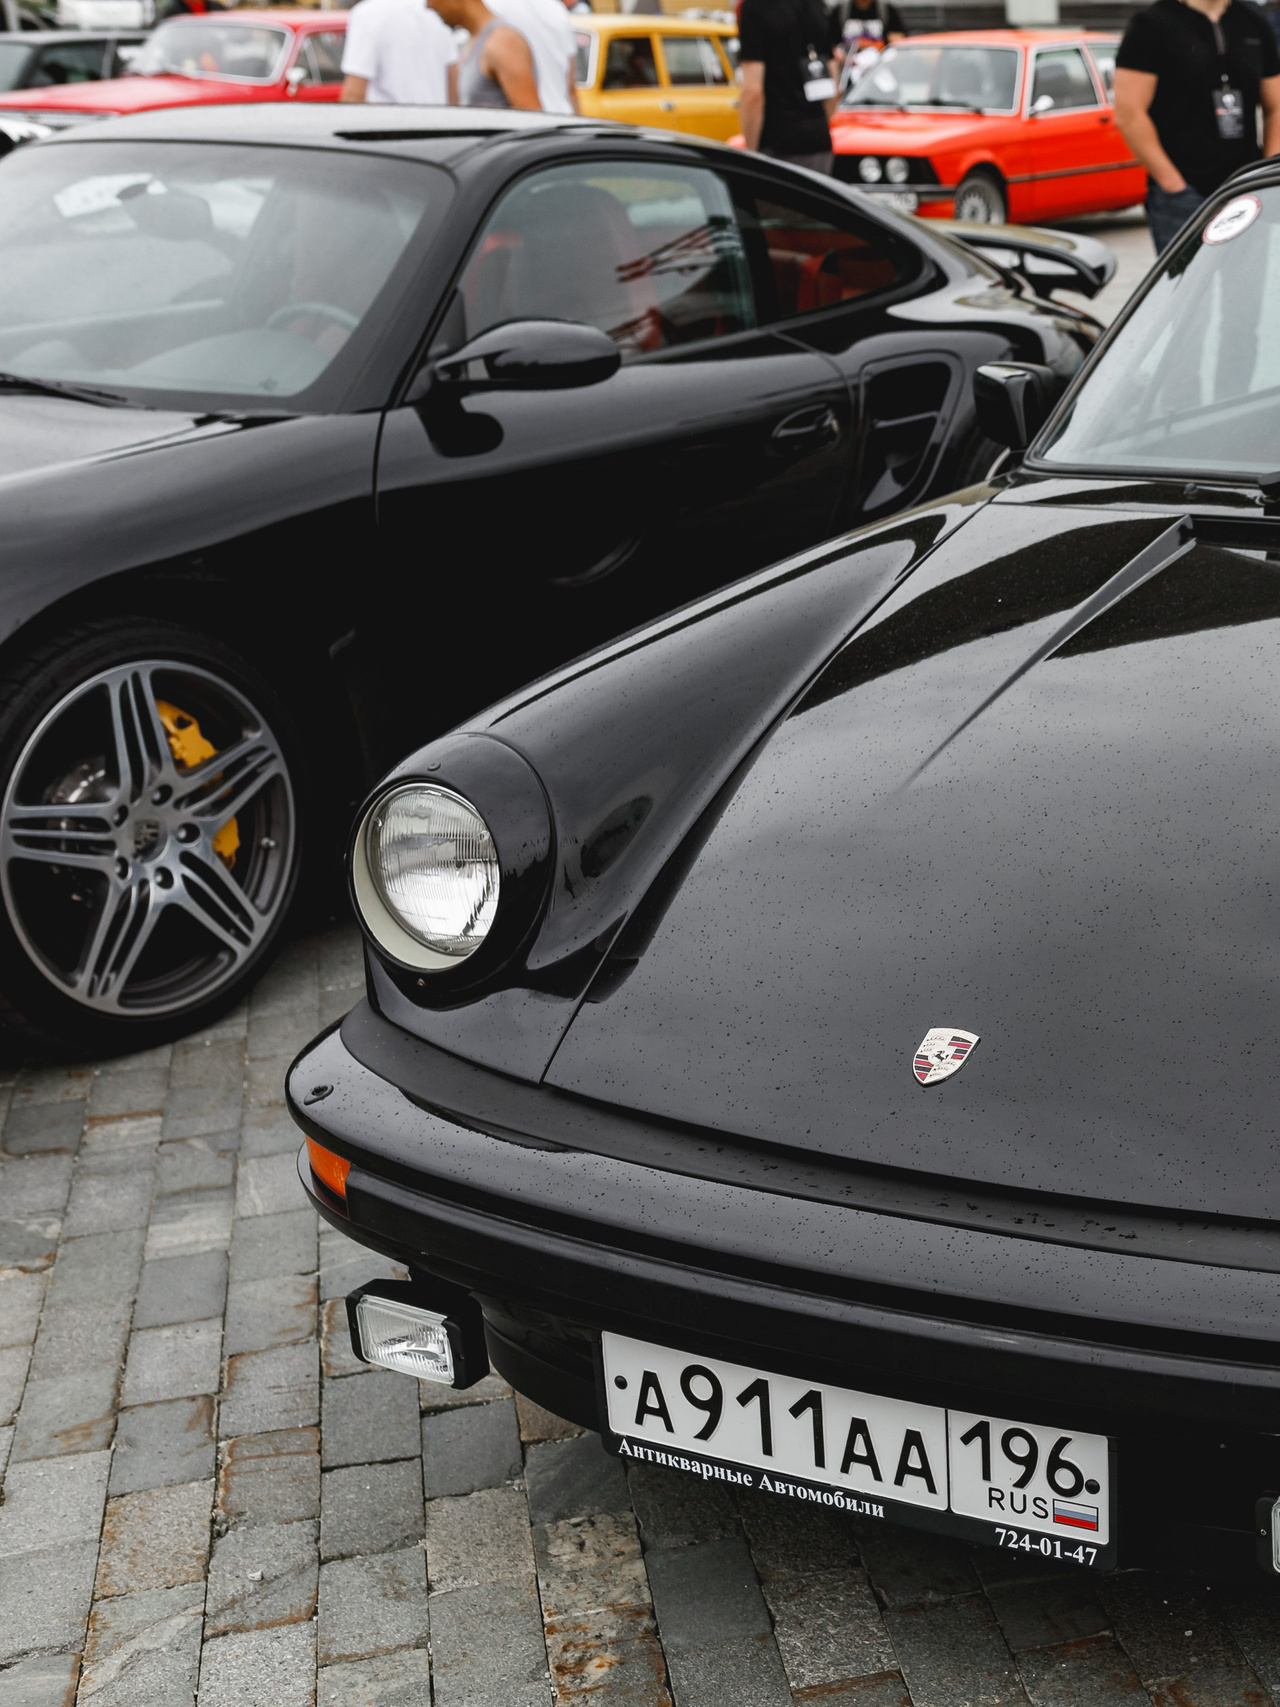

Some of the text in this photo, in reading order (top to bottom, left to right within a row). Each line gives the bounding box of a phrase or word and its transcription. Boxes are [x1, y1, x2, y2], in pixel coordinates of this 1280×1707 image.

[618, 1438, 885, 1518] Антикварные Автомобили
[960, 1420, 1085, 1498] 196
[988, 1487, 1049, 1519] RUS
[995, 1527, 1098, 1566] 724-01-47
